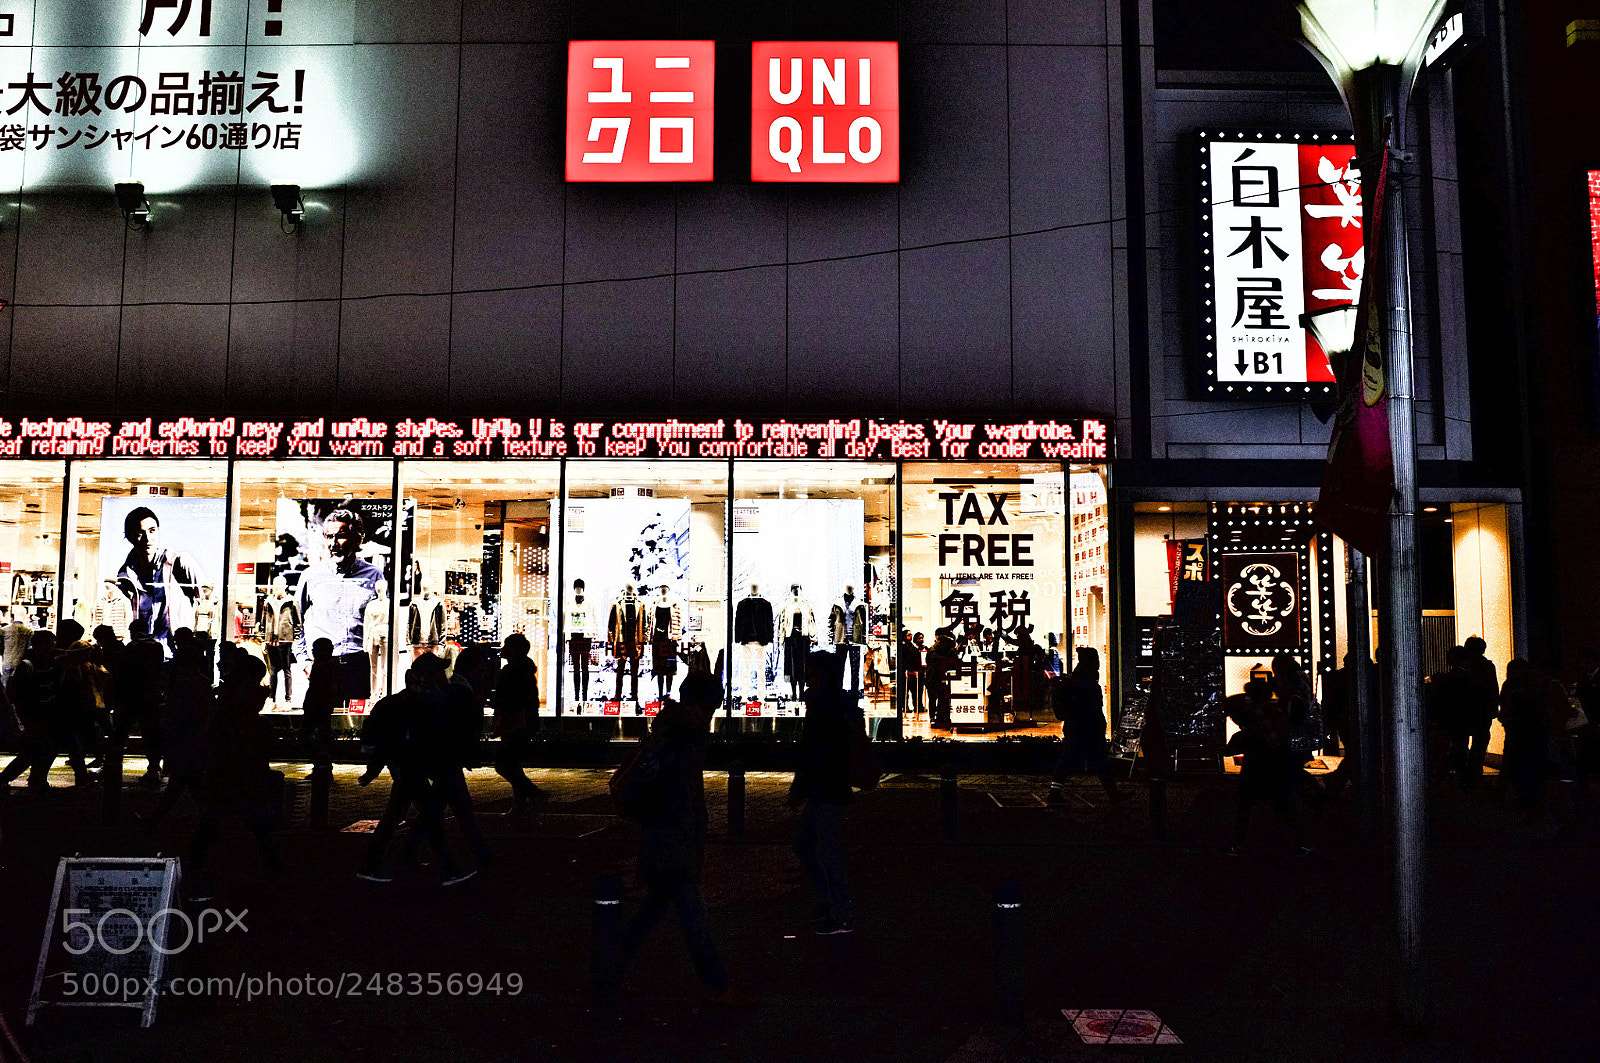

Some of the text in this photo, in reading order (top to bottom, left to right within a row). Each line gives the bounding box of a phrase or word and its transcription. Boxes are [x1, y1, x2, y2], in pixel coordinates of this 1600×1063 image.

[0, 70, 305, 117] 大級の品揃え!
[588, 57, 694, 103] ユニ
[769, 58, 871, 105] UNI
[582, 117, 694, 164] クロ
[768, 116, 882, 173] QLO
[1227, 147, 1291, 330] 白木屋
[1253, 351, 1283, 375] B1
[119, 417, 152, 437] and
[291, 417, 324, 438] and
[550, 418, 566, 438] is
[573, 423, 604, 438] our
[612, 419, 725, 439] commitment
[734, 419, 754, 439] to
[209, 436, 228, 455] to
[329, 440, 384, 456] warm
[392, 436, 424, 456] and
[433, 440, 444, 456] a
[453, 437, 492, 456] soft
[502, 436, 567, 456] texture
[577, 437, 596, 456] to
[699, 437, 808, 457] comfortable
[818, 437, 836, 457] all
[891, 437, 931, 458] Best
[940, 438, 969, 459] for
[978, 438, 1031, 459] cooler
[938, 492, 1009, 526] TAX
[938, 533, 1034, 567] FREE
[940, 589, 1035, 635] 免税
